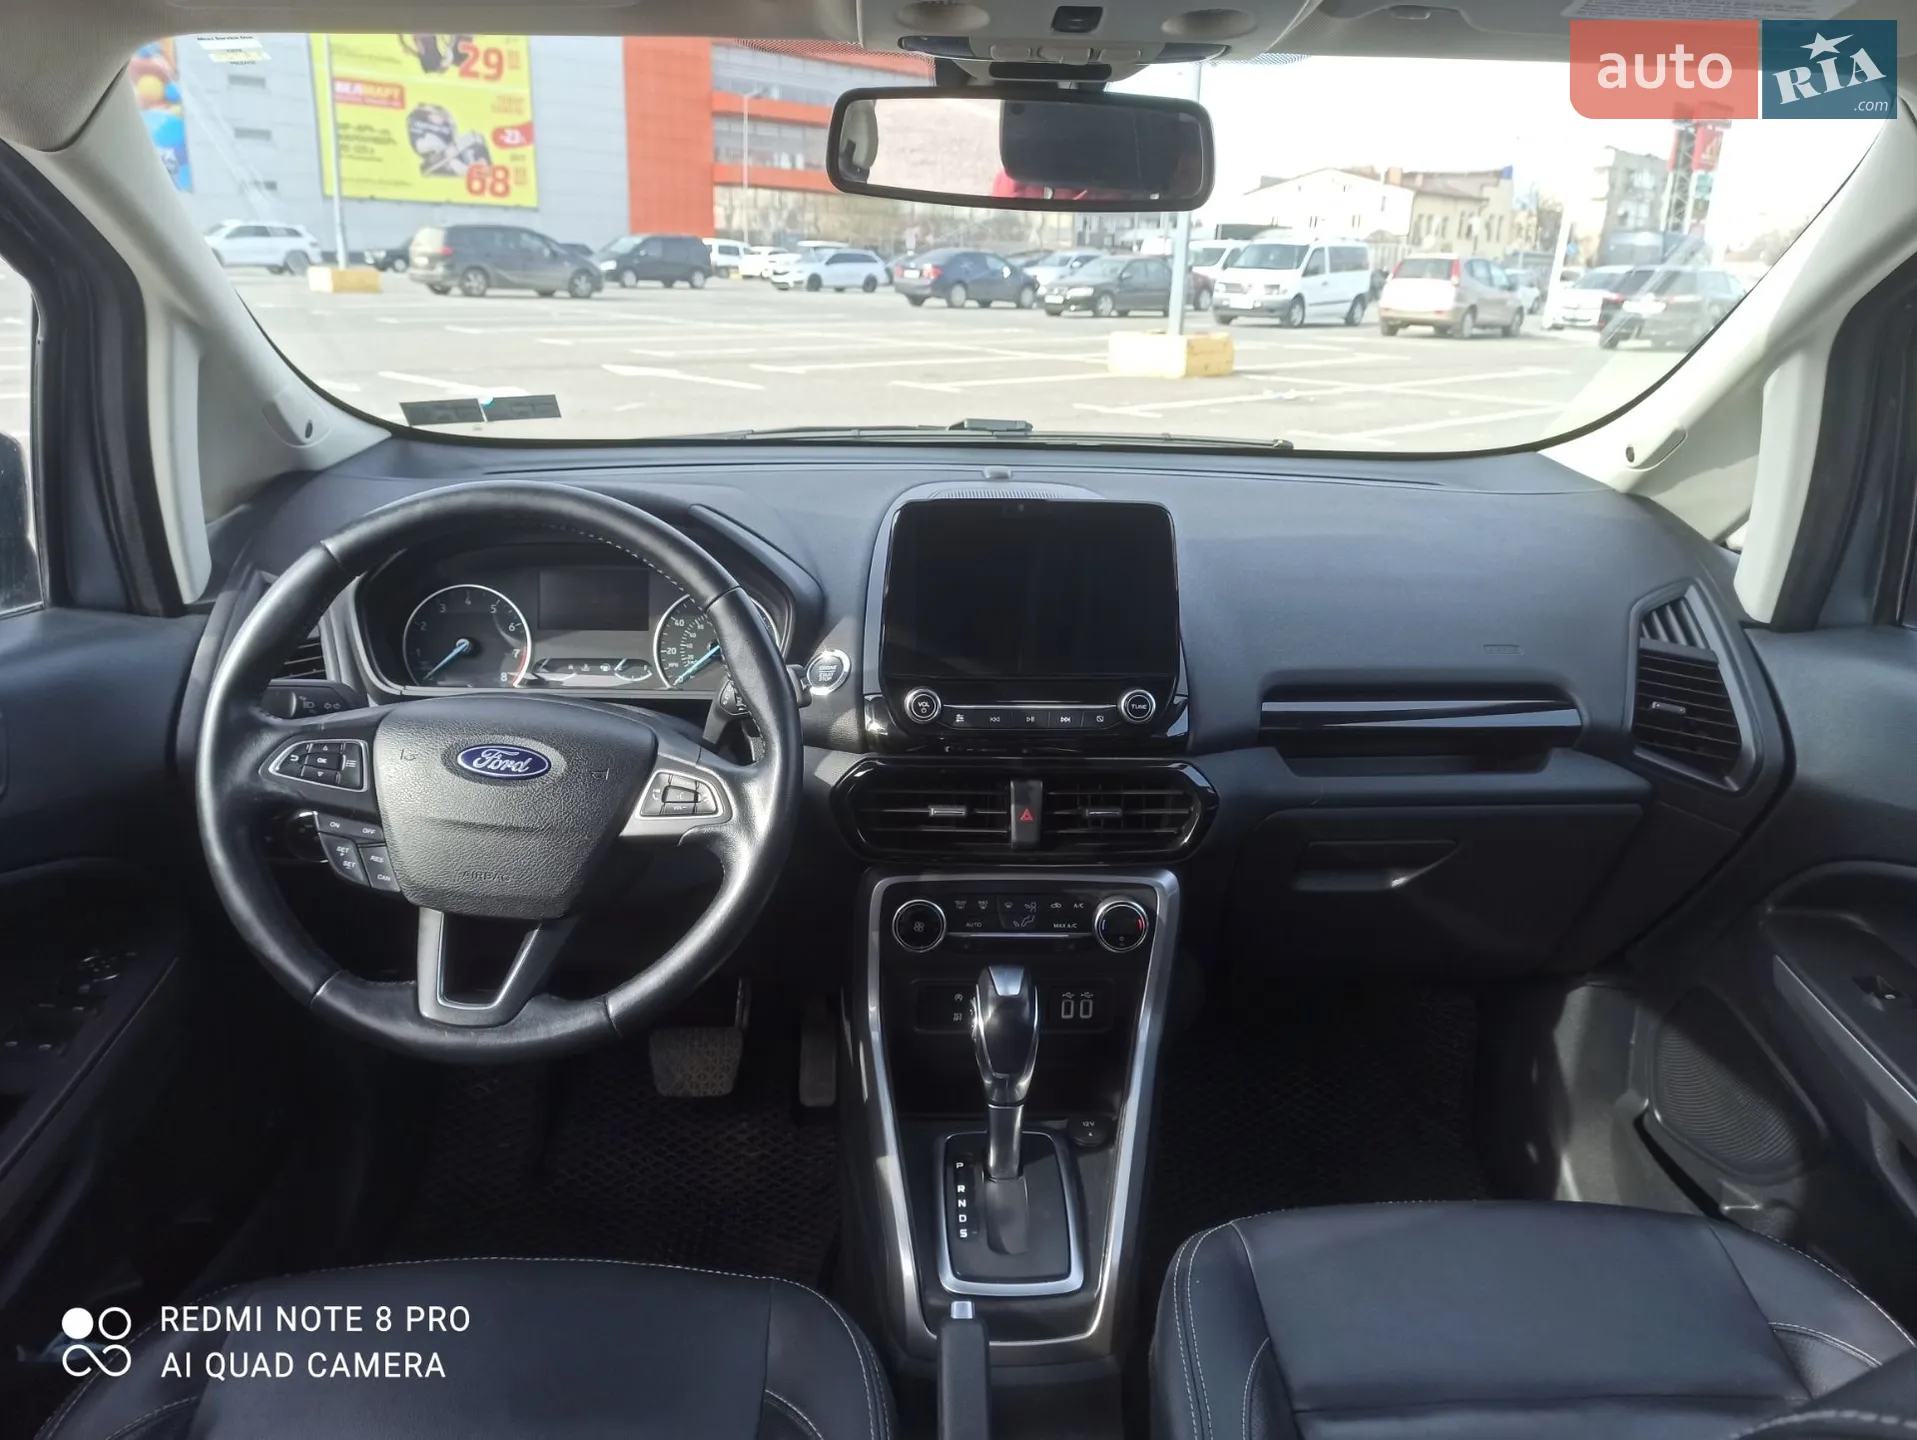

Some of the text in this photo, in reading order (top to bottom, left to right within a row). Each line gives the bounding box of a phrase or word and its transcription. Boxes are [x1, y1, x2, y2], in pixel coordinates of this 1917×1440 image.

[458, 41, 503, 82] 29
[465, 162, 511, 198] 68
[490, 604, 497, 614] 5
[508, 622, 516, 632] 6
[674, 619, 685, 627] 40
[666, 647, 677, 655] 20
[500, 672, 507, 682] 8
[472, 748, 533, 773] Ford
[329, 821, 340, 829] ON
[362, 827, 376, 835] OFF
[336, 846, 350, 854] SET
[369, 855, 384, 863] RES
[342, 860, 356, 868] SET
[377, 873, 391, 882] CAN
[957, 1185, 966, 1193] R
[958, 1199, 967, 1208] N
[958, 1214, 967, 1223] D
[959, 1229, 968, 1238] S
